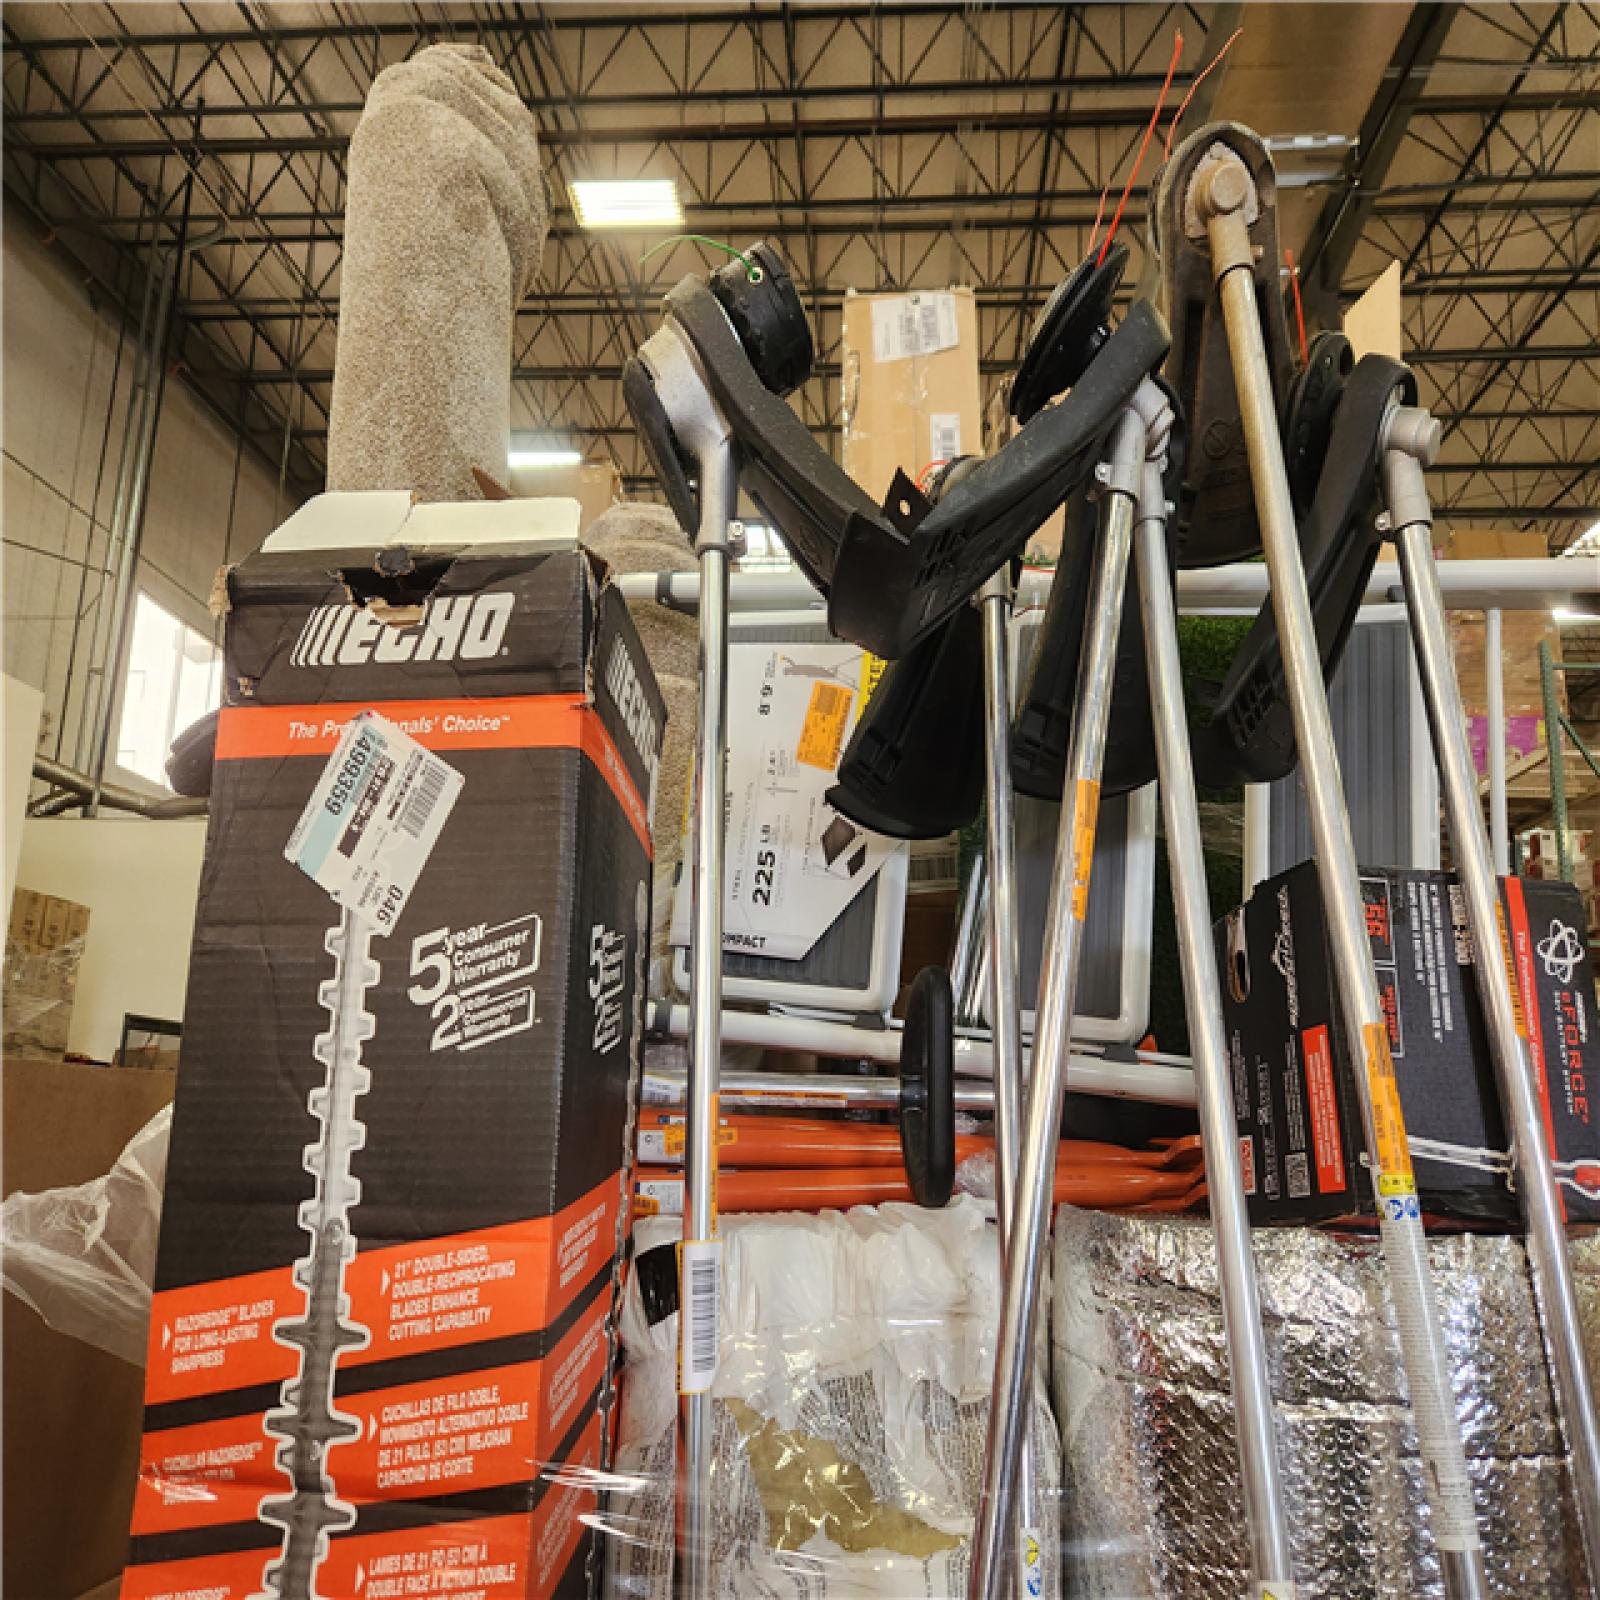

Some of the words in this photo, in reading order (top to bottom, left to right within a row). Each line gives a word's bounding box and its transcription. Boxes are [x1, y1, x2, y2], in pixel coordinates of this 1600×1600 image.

[336, 591, 516, 665] ECHO
[289, 721, 318, 739] The
[752, 850, 776, 906] 225
[407, 926, 450, 1005] 5
[455, 929, 530, 966] Consumer
[455, 949, 520, 985] Warranty
[430, 993, 462, 1052] 2
[389, 1317, 432, 1341] CUTTING
